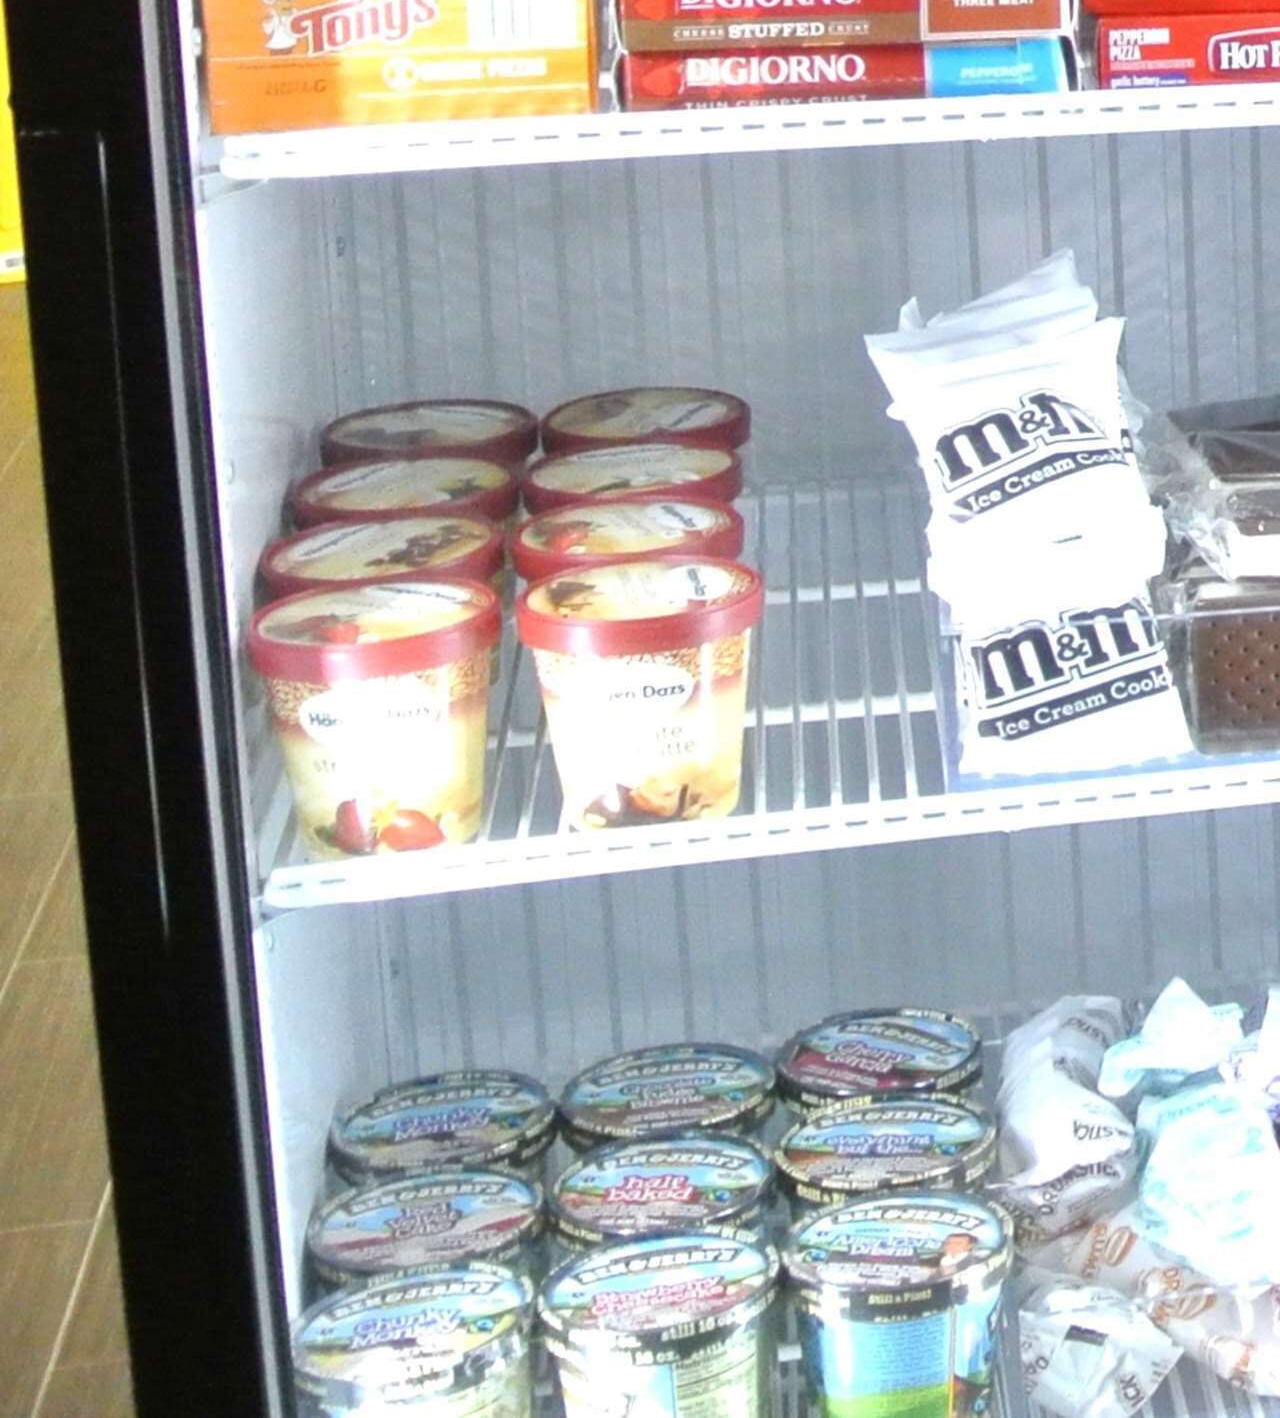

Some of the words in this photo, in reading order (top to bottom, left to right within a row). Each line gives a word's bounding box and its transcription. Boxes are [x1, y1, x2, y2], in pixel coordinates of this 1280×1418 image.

[727, 22, 825, 38] STUFFED
[1219, 40, 1268, 68] HOT
[685, 54, 866, 87] DIGIORNO
[968, 482, 1002, 513] Ice
[1004, 456, 1076, 498] Cream
[996, 708, 1031, 739] Ice
[1033, 688, 1107, 725] Cream
[606, 1186, 693, 1203] baked
[625, 1174, 683, 1190] half
[353, 1309, 461, 1334] Chunky
